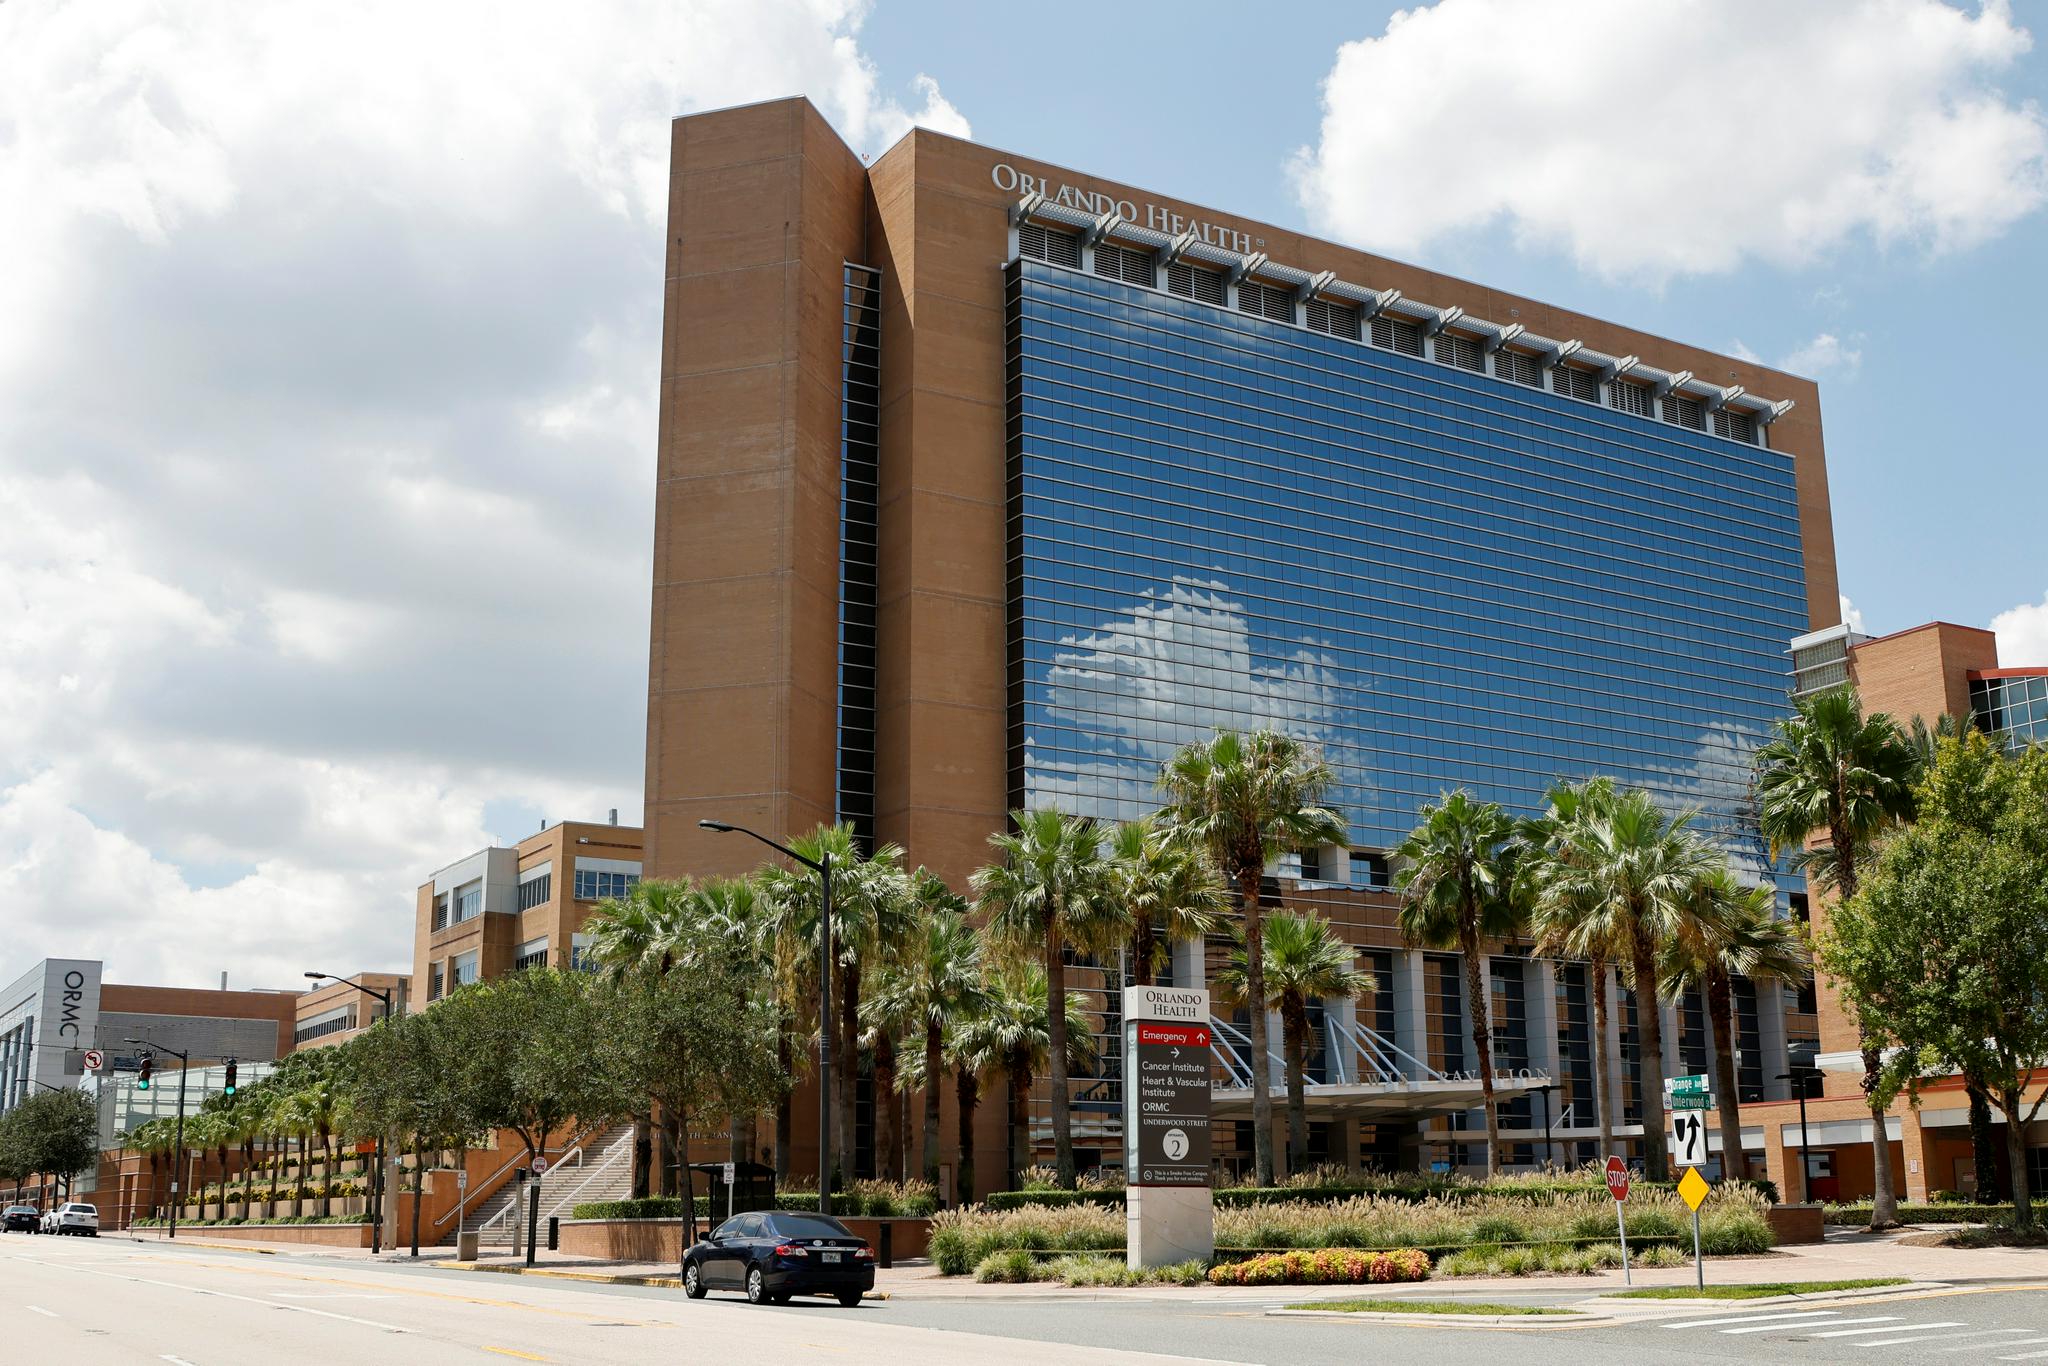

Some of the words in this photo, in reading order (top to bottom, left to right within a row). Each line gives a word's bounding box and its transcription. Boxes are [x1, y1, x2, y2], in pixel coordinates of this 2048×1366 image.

[991, 164, 1137, 222] ORLANDO
[1145, 203, 1251, 254] HEALTH
[59, 971, 84, 1037] ORMC
[1146, 990, 1202, 1005] ORLANDO
[1153, 1004, 1196, 1017] HEALTH
[1142, 1030, 1187, 1043] Emergency
[1142, 1061, 1170, 1071] Cancer
[1172, 1062, 1205, 1072] Institute
[1142, 1076, 1165, 1086] Heart
[1167, 1076, 1174, 1086] &
[1175, 1077, 1208, 1087] Vascular
[1438, 1068, 1549, 1083] PAVLION
[1142, 1087, 1176, 1097] Institute
[1142, 1102, 1170, 1112] ORMC
[1143, 1118, 1186, 1126] UNDERWOOD
[1187, 1119, 1209, 1127] STREET
[1171, 1140, 1181, 1157] 2
[1608, 1170, 1626, 1187] STOP
